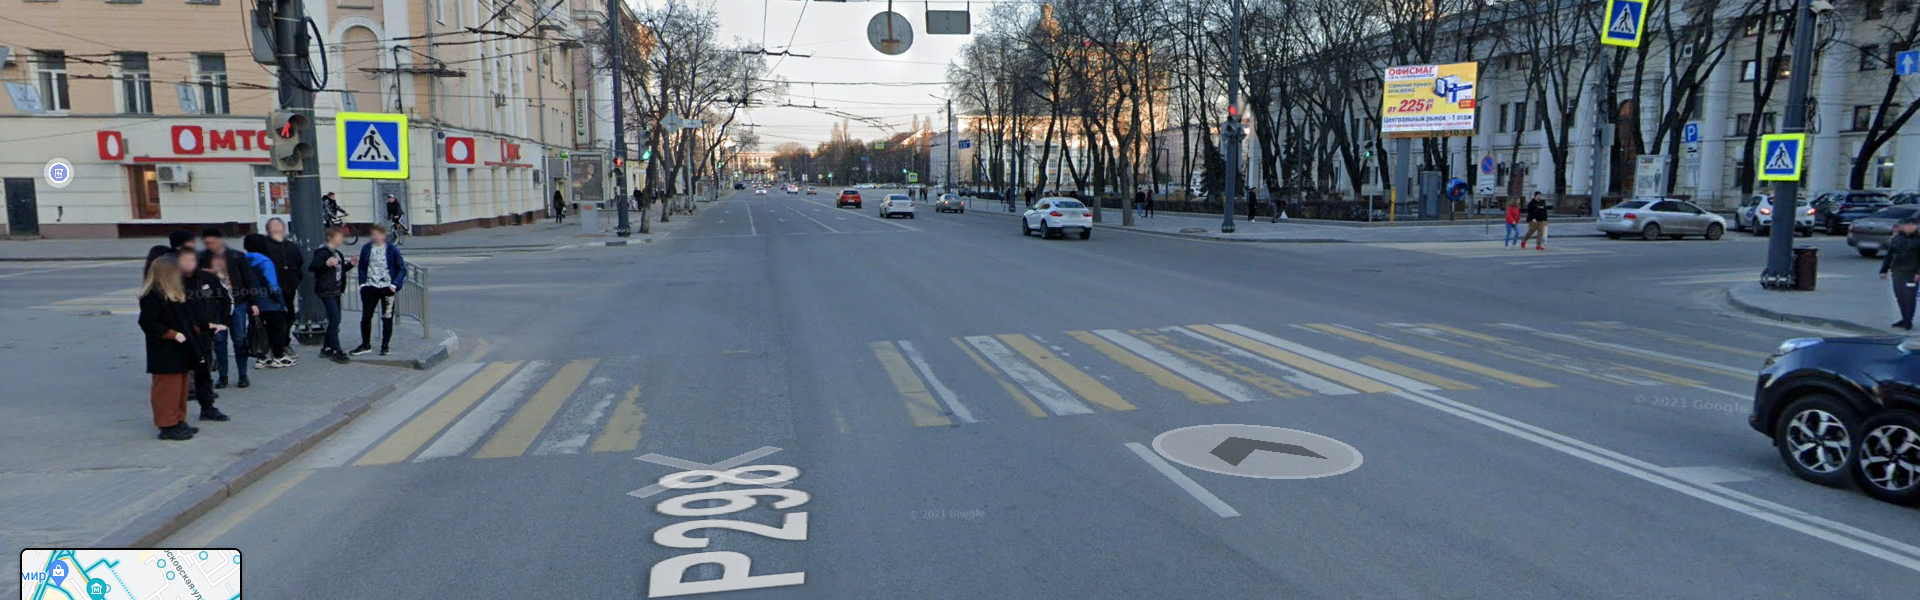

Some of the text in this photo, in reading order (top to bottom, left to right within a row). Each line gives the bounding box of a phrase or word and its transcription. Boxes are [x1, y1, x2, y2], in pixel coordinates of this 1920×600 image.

[1389, 66, 1435, 76] ОФИСМАГ
[1398, 99, 1425, 112] 225
[1383, 116, 1425, 124] Центральный
[209, 129, 272, 151] МТС
